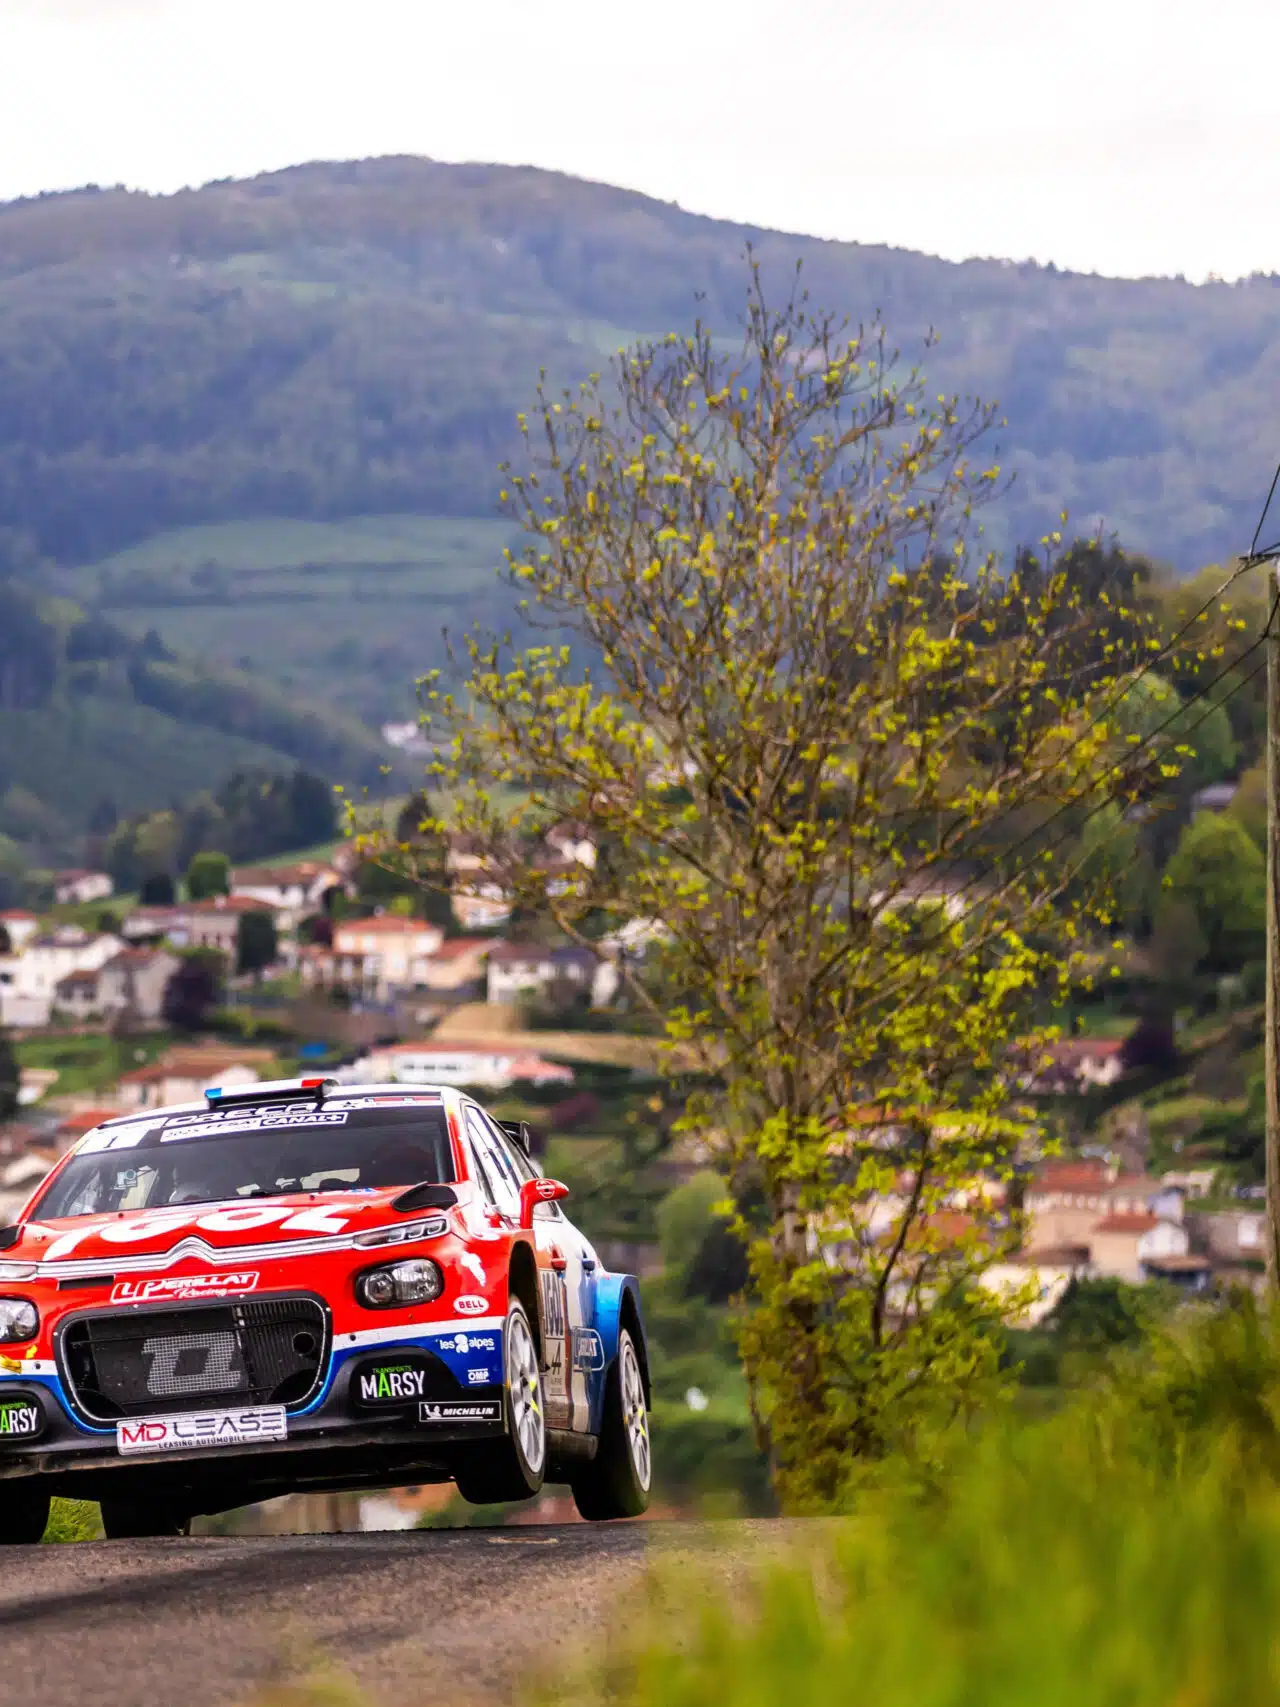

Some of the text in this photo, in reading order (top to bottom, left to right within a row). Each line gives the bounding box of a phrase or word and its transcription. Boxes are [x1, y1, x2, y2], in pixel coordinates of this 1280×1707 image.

[164, 1103, 318, 1127] ORECA
[261, 1114, 342, 1127] CANAL+
[42, 1204, 362, 1262] IGOL
[173, 1287, 228, 1299] Racing
[458, 1300, 484, 1309] BELL
[439, 1339, 455, 1350] les
[468, 1336, 495, 1350] alpes
[467, 1370, 489, 1381] OMP
[360, 1370, 425, 1399] MARSY
[442, 1407, 494, 1416] MICHELIN
[122, 1412, 282, 1444] MD LEASE
[158, 1435, 248, 1449] LEASING AUTOMOBILE
